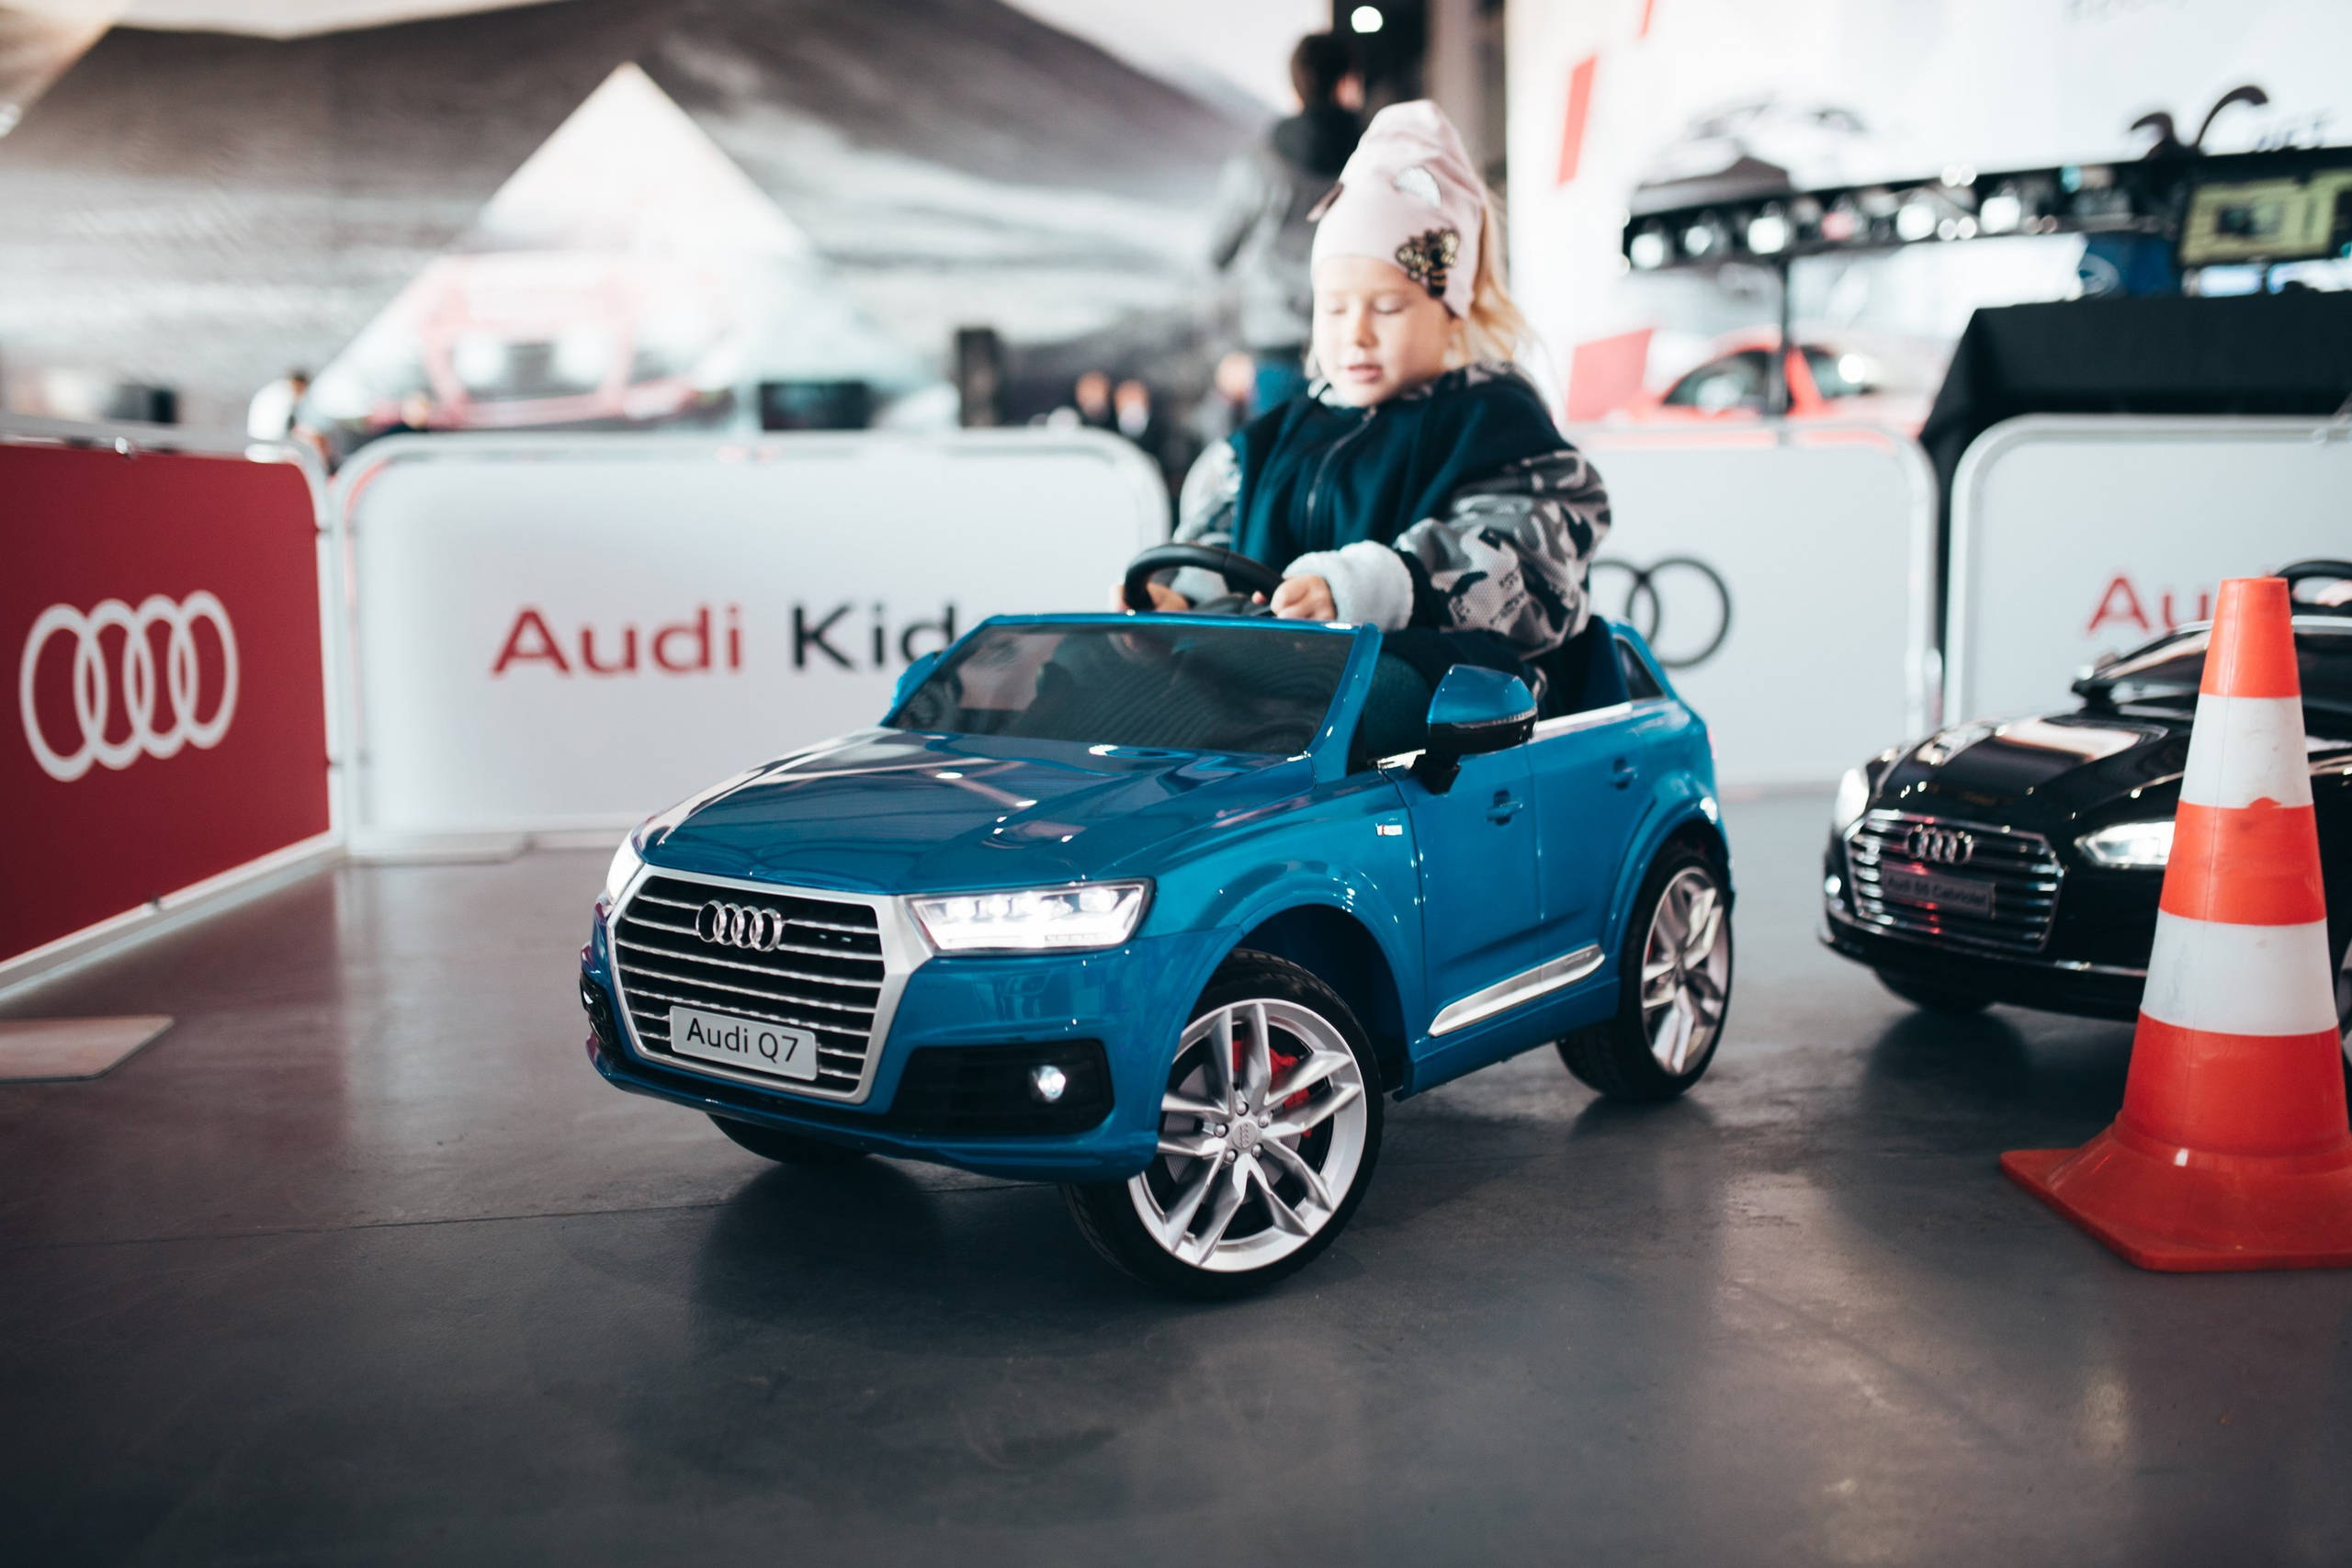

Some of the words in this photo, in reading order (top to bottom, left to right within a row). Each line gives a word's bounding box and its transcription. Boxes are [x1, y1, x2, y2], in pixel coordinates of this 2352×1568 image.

[2085, 573, 2211, 634] Au
[491, 604, 742, 677] Audi
[790, 603, 957, 672] Kid
[686, 1017, 749, 1054] Audi
[758, 1032, 799, 1064] Q7
